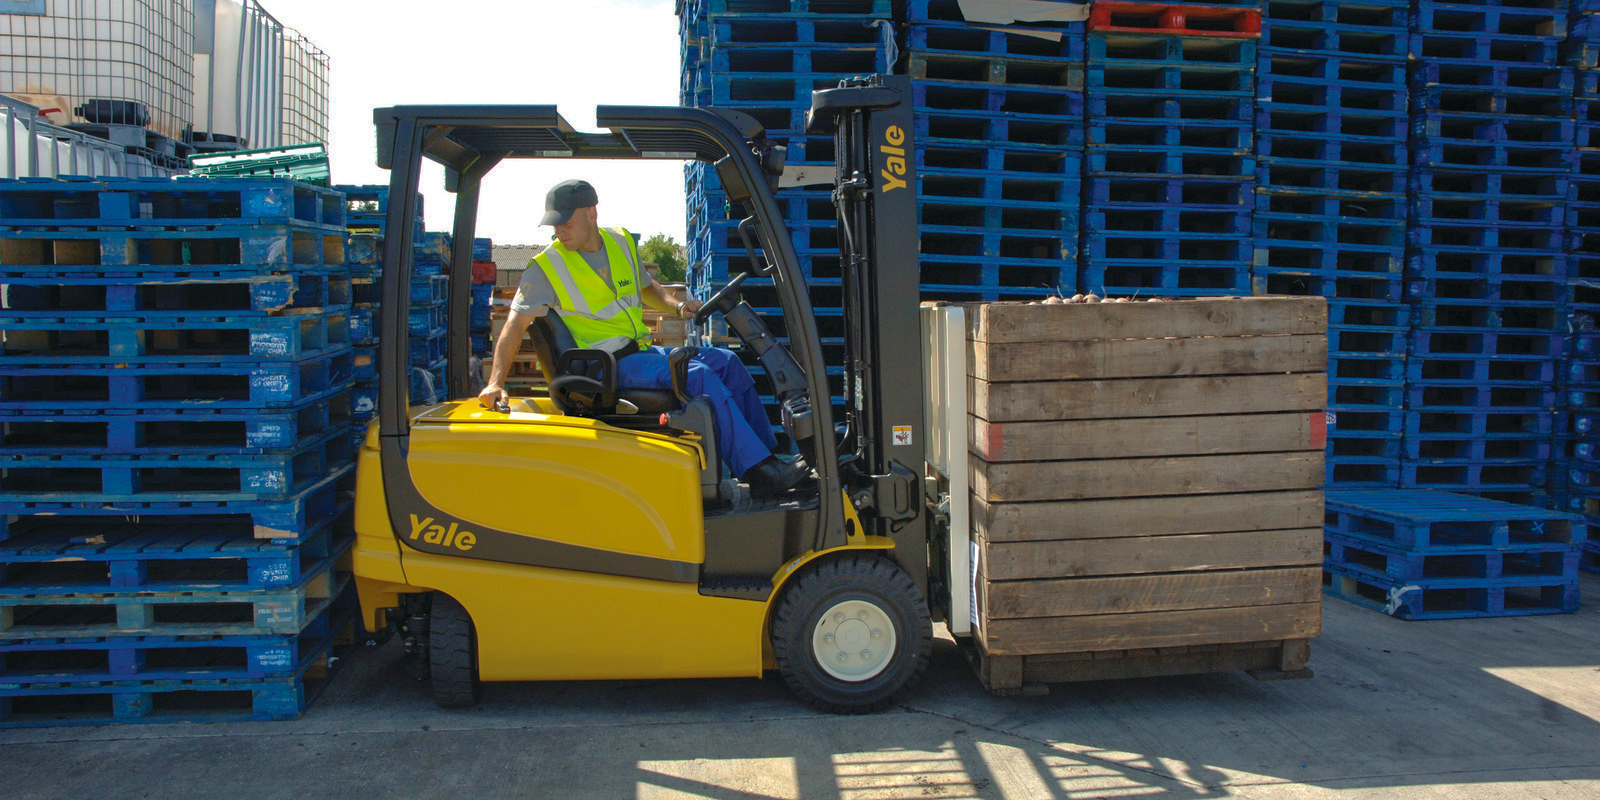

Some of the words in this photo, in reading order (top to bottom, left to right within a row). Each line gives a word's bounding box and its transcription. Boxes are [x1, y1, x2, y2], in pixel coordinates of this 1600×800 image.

[880, 125, 906, 192] Yale
[617, 279, 630, 287] Yale
[409, 513, 477, 551] Yale
